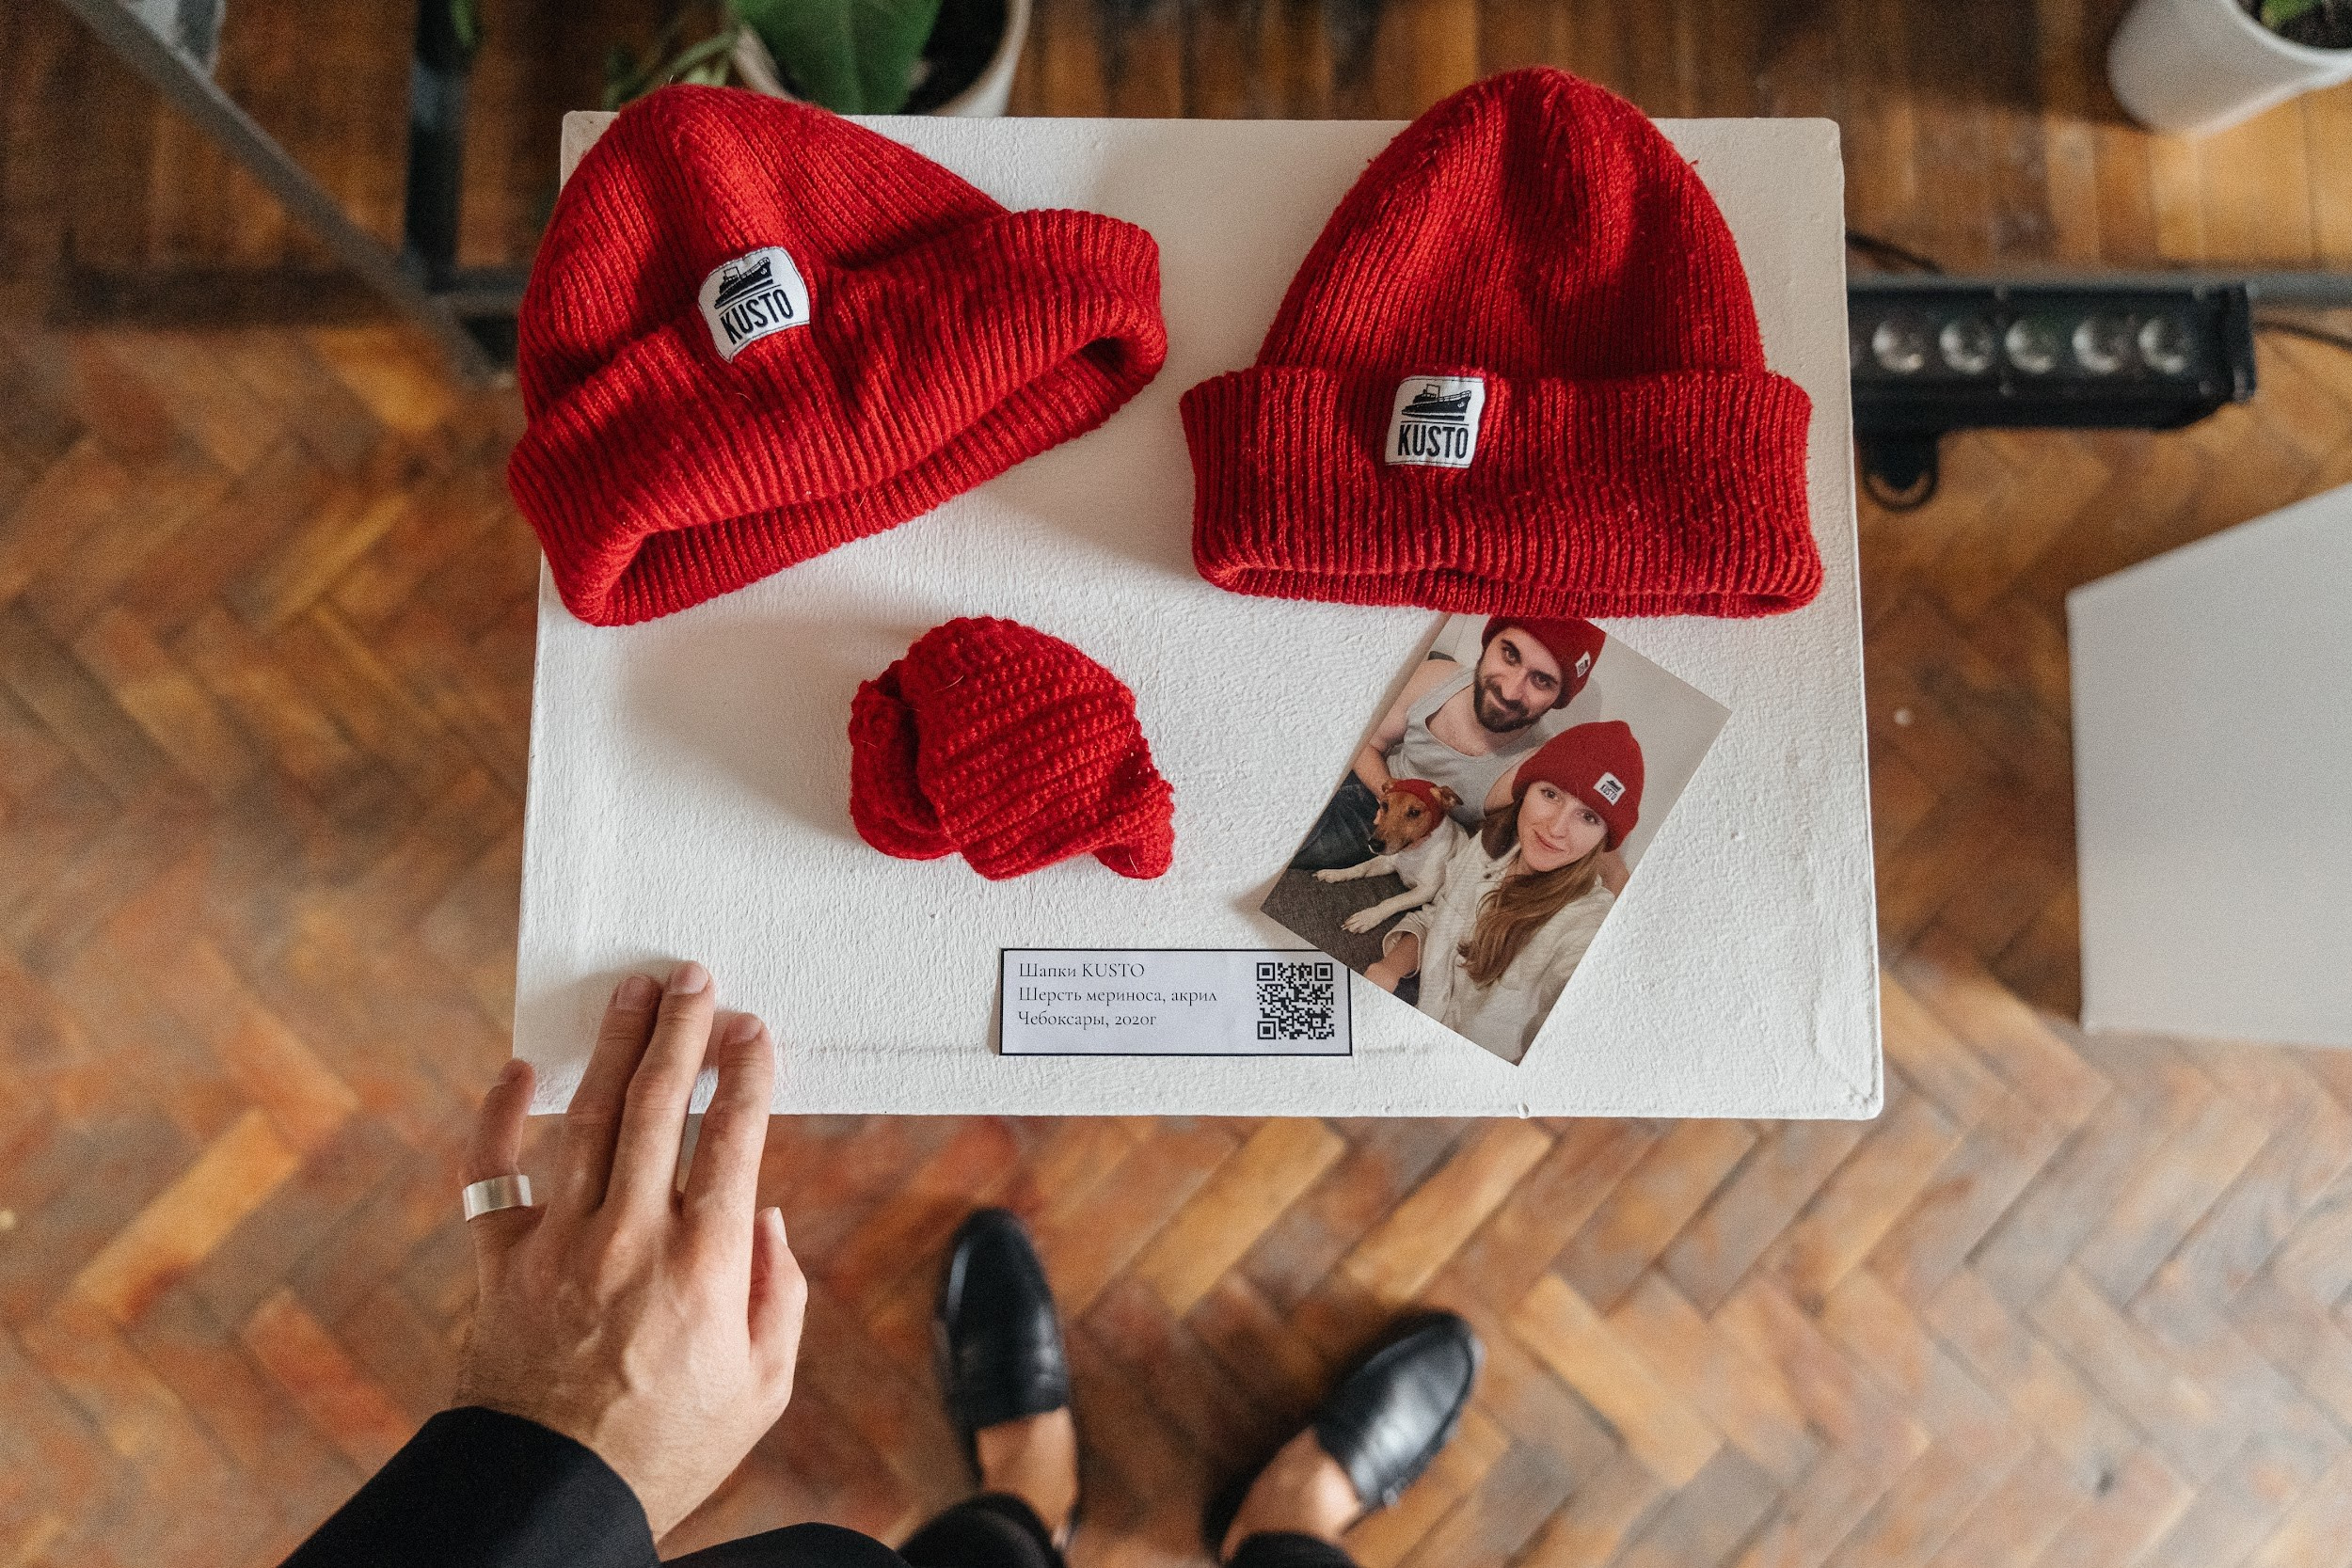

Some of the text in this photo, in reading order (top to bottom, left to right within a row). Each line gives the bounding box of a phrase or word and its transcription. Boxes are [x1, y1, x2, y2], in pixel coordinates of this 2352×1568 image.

[720, 289, 794, 345] KUSTO
[1397, 424, 1469, 459] KUSTO
[1599, 784, 1617, 800] KUSTO
[1019, 962, 1145, 978] Шапки KUSTO
[1019, 987, 1217, 1006] Шерсть мериноса, акрил
[1018, 1009, 1157, 1031] Чебоксары, 2020г
